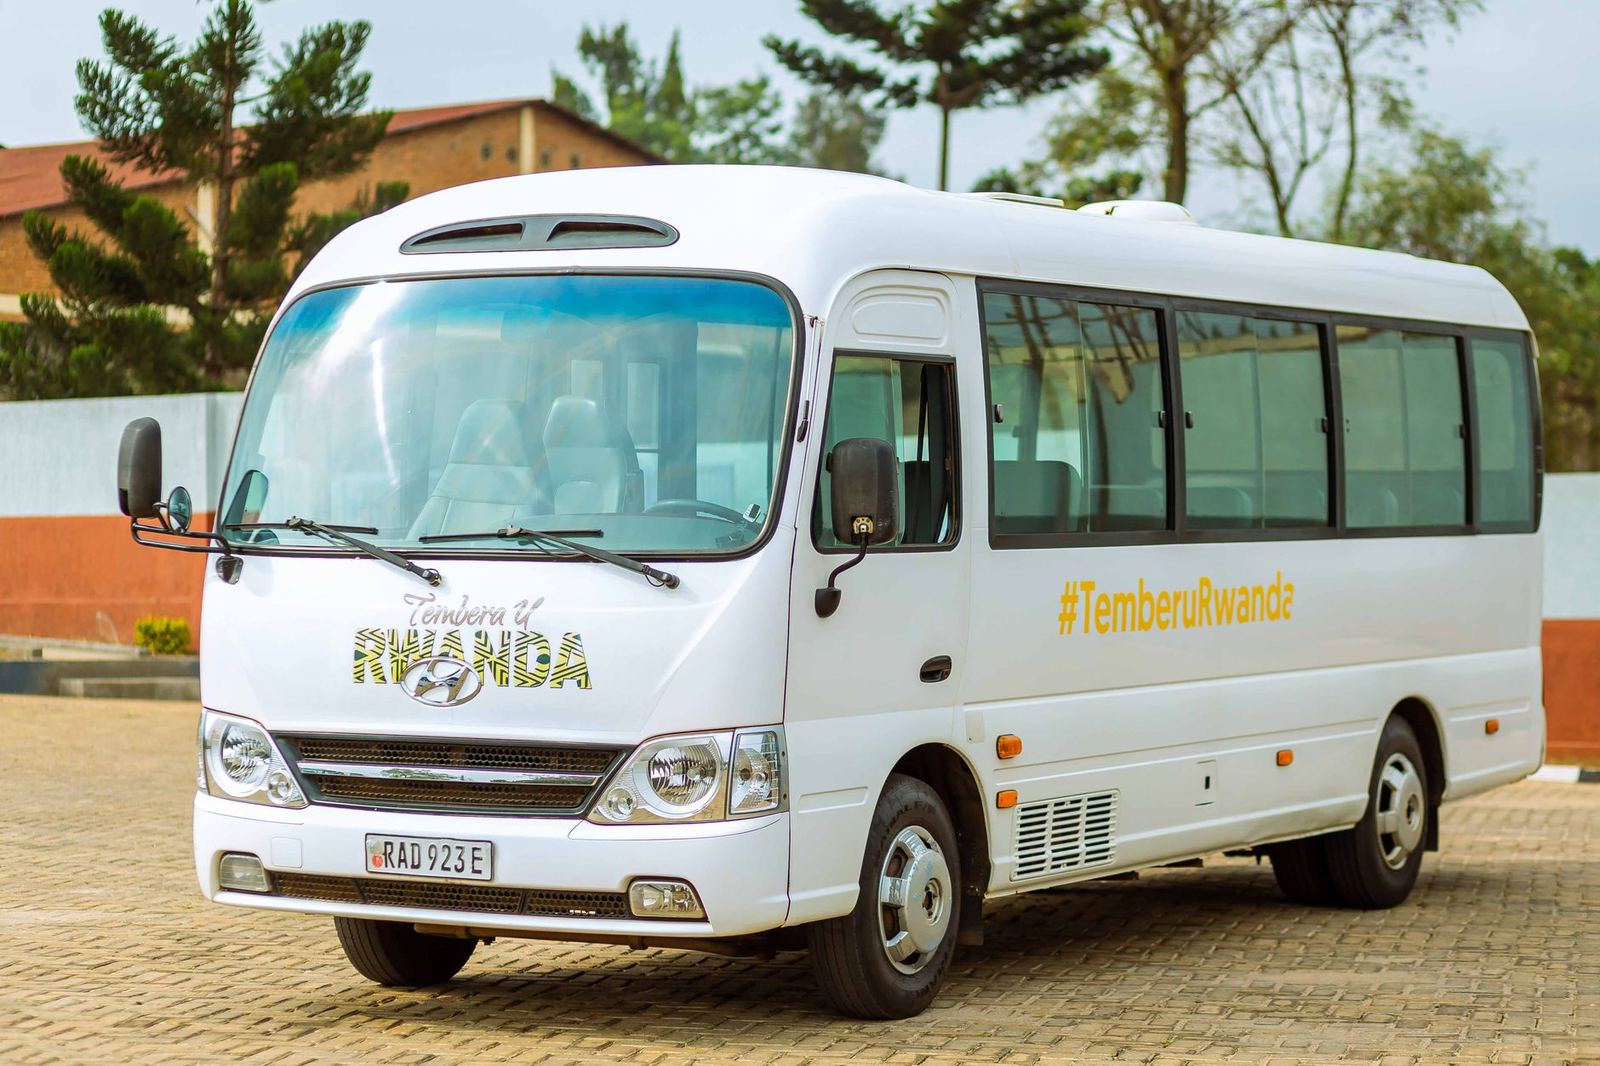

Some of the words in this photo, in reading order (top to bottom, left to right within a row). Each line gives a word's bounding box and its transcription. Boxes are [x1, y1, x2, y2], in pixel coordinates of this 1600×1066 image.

[403, 593, 505, 627] Tembera
[1058, 570, 1295, 635] #TemberuRwanda
[383, 841, 421, 870] RAD
[428, 844, 465, 873] 923
[471, 847, 483, 875] E
